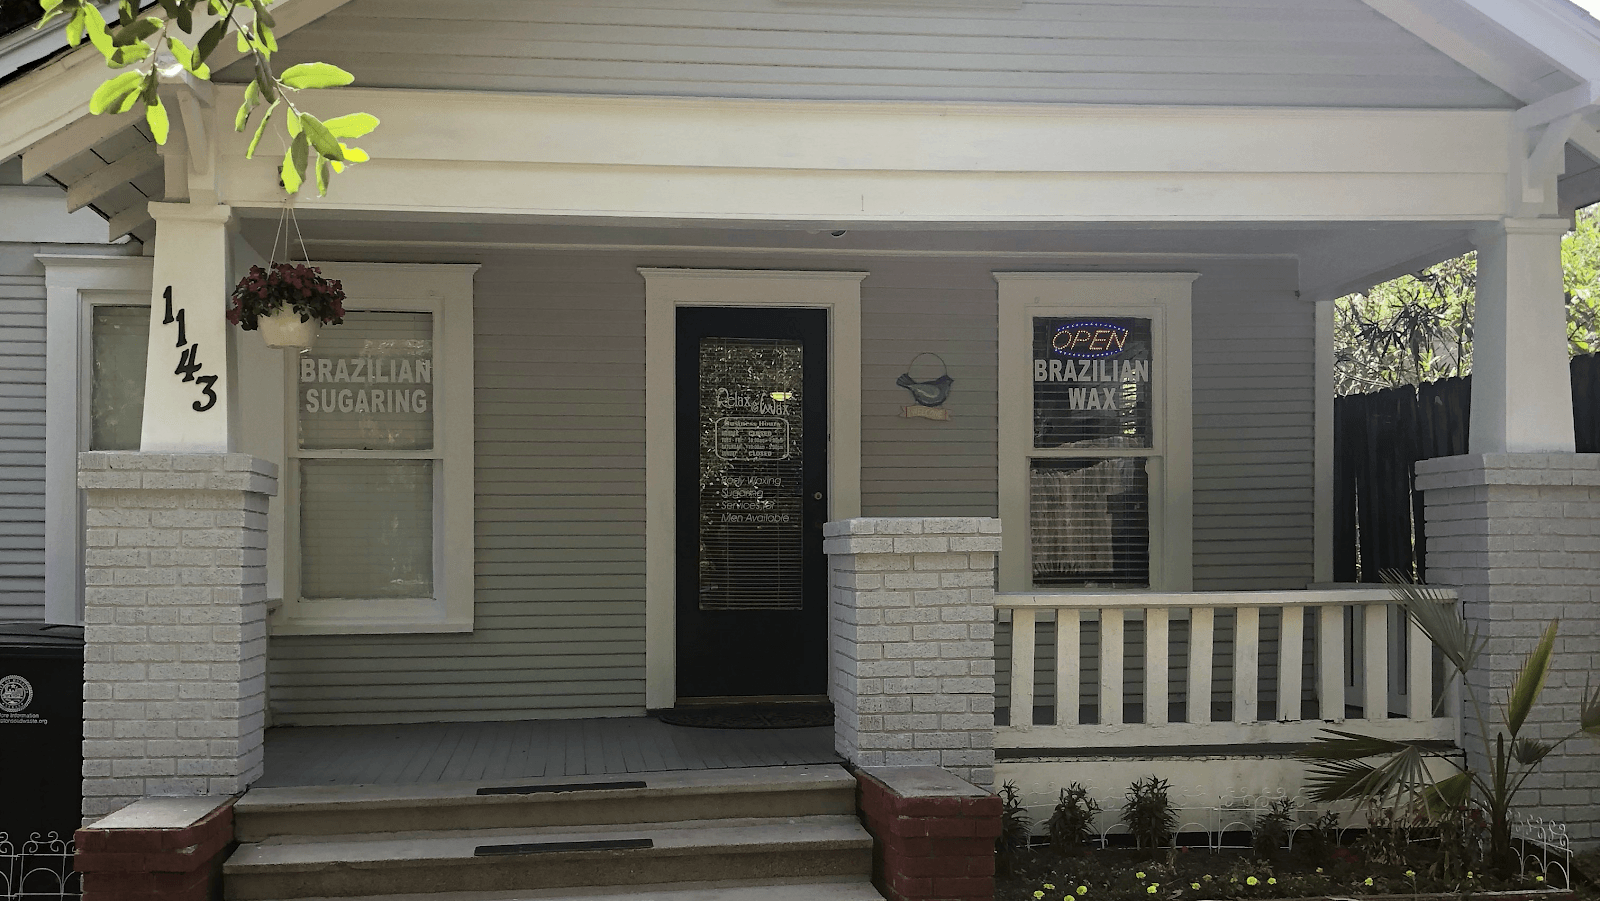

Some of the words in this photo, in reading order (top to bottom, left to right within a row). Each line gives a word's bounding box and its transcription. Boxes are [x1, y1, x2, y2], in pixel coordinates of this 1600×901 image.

[163, 285, 219, 412] 1143
[1052, 329, 1129, 351] OPEN
[300, 358, 431, 382] BRAZILIAN
[1034, 359, 1149, 382] BRAZILIAN
[305, 388, 427, 413] SUGARING
[716, 387, 751, 408] Relax
[1068, 387, 1117, 410] WAX
[747, 476, 782, 487] Waxing
[721, 488, 764, 499] Sugaring
[721, 514, 743, 522] Men
[745, 513, 790, 523] Available
